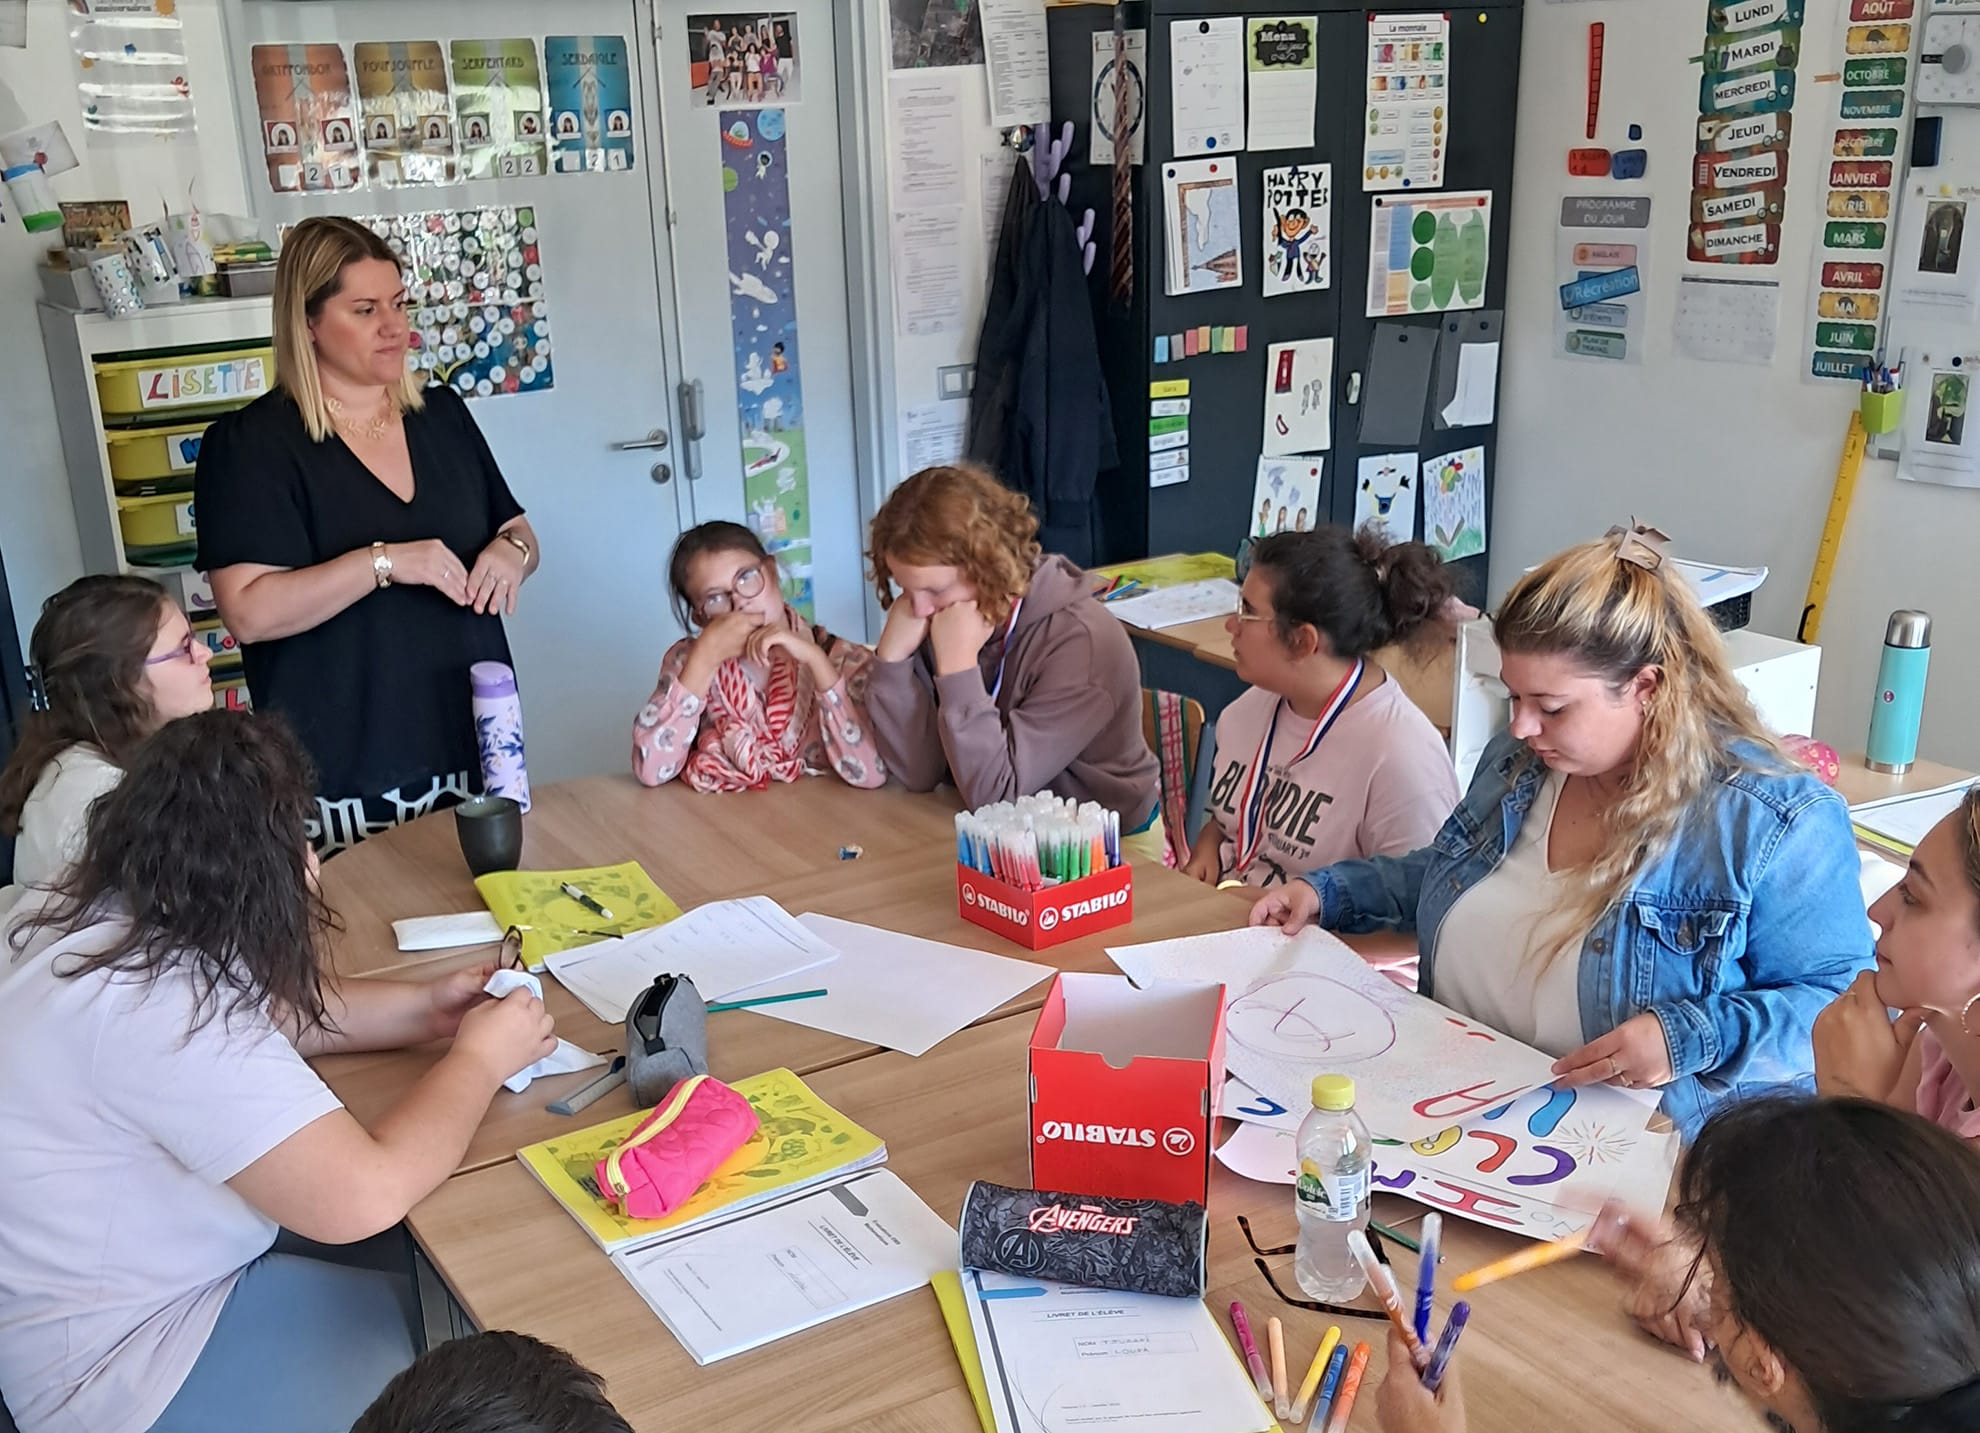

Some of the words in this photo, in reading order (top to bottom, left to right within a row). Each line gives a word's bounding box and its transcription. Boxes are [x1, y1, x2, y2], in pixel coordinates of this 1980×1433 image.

[1735, 4, 1774, 23] LUNDI
[1260, 31, 1296, 42] Menu
[1731, 42, 1775, 61] MARDI
[1846, 69, 1889, 80] OCTOBRE
[1714, 80, 1771, 100] MERCREDI
[1843, 104, 1891, 115] NOVEMBRE
[1728, 124, 1765, 140] JEUDI
[505, 160, 514, 174] 2
[525, 159, 533, 173] 2
[1713, 167, 1776, 178] VENDREDI
[309, 167, 318, 181] 2
[1831, 173, 1878, 184] JANVIER
[1576, 200, 1637, 210] PROGRAMME
[1707, 197, 1756, 217] SAMEDI
[1584, 214, 1597, 223] DU
[1600, 214, 1625, 224] JOUR
[1706, 233, 1764, 248] DIMANCHE
[1833, 232, 1866, 244] MARS
[1832, 271, 1863, 282] AVRIL
[1575, 273, 1638, 298] Récréation
[1829, 332, 1854, 344] JUIN
[1815, 362, 1854, 373] JUILLET
[977, 893, 1028, 926] STABILO
[1061, 890, 1128, 922] STABILO
[1042, 1121, 1156, 1147] STABILO
[1047, 1311, 1076, 1319] LIVRET
